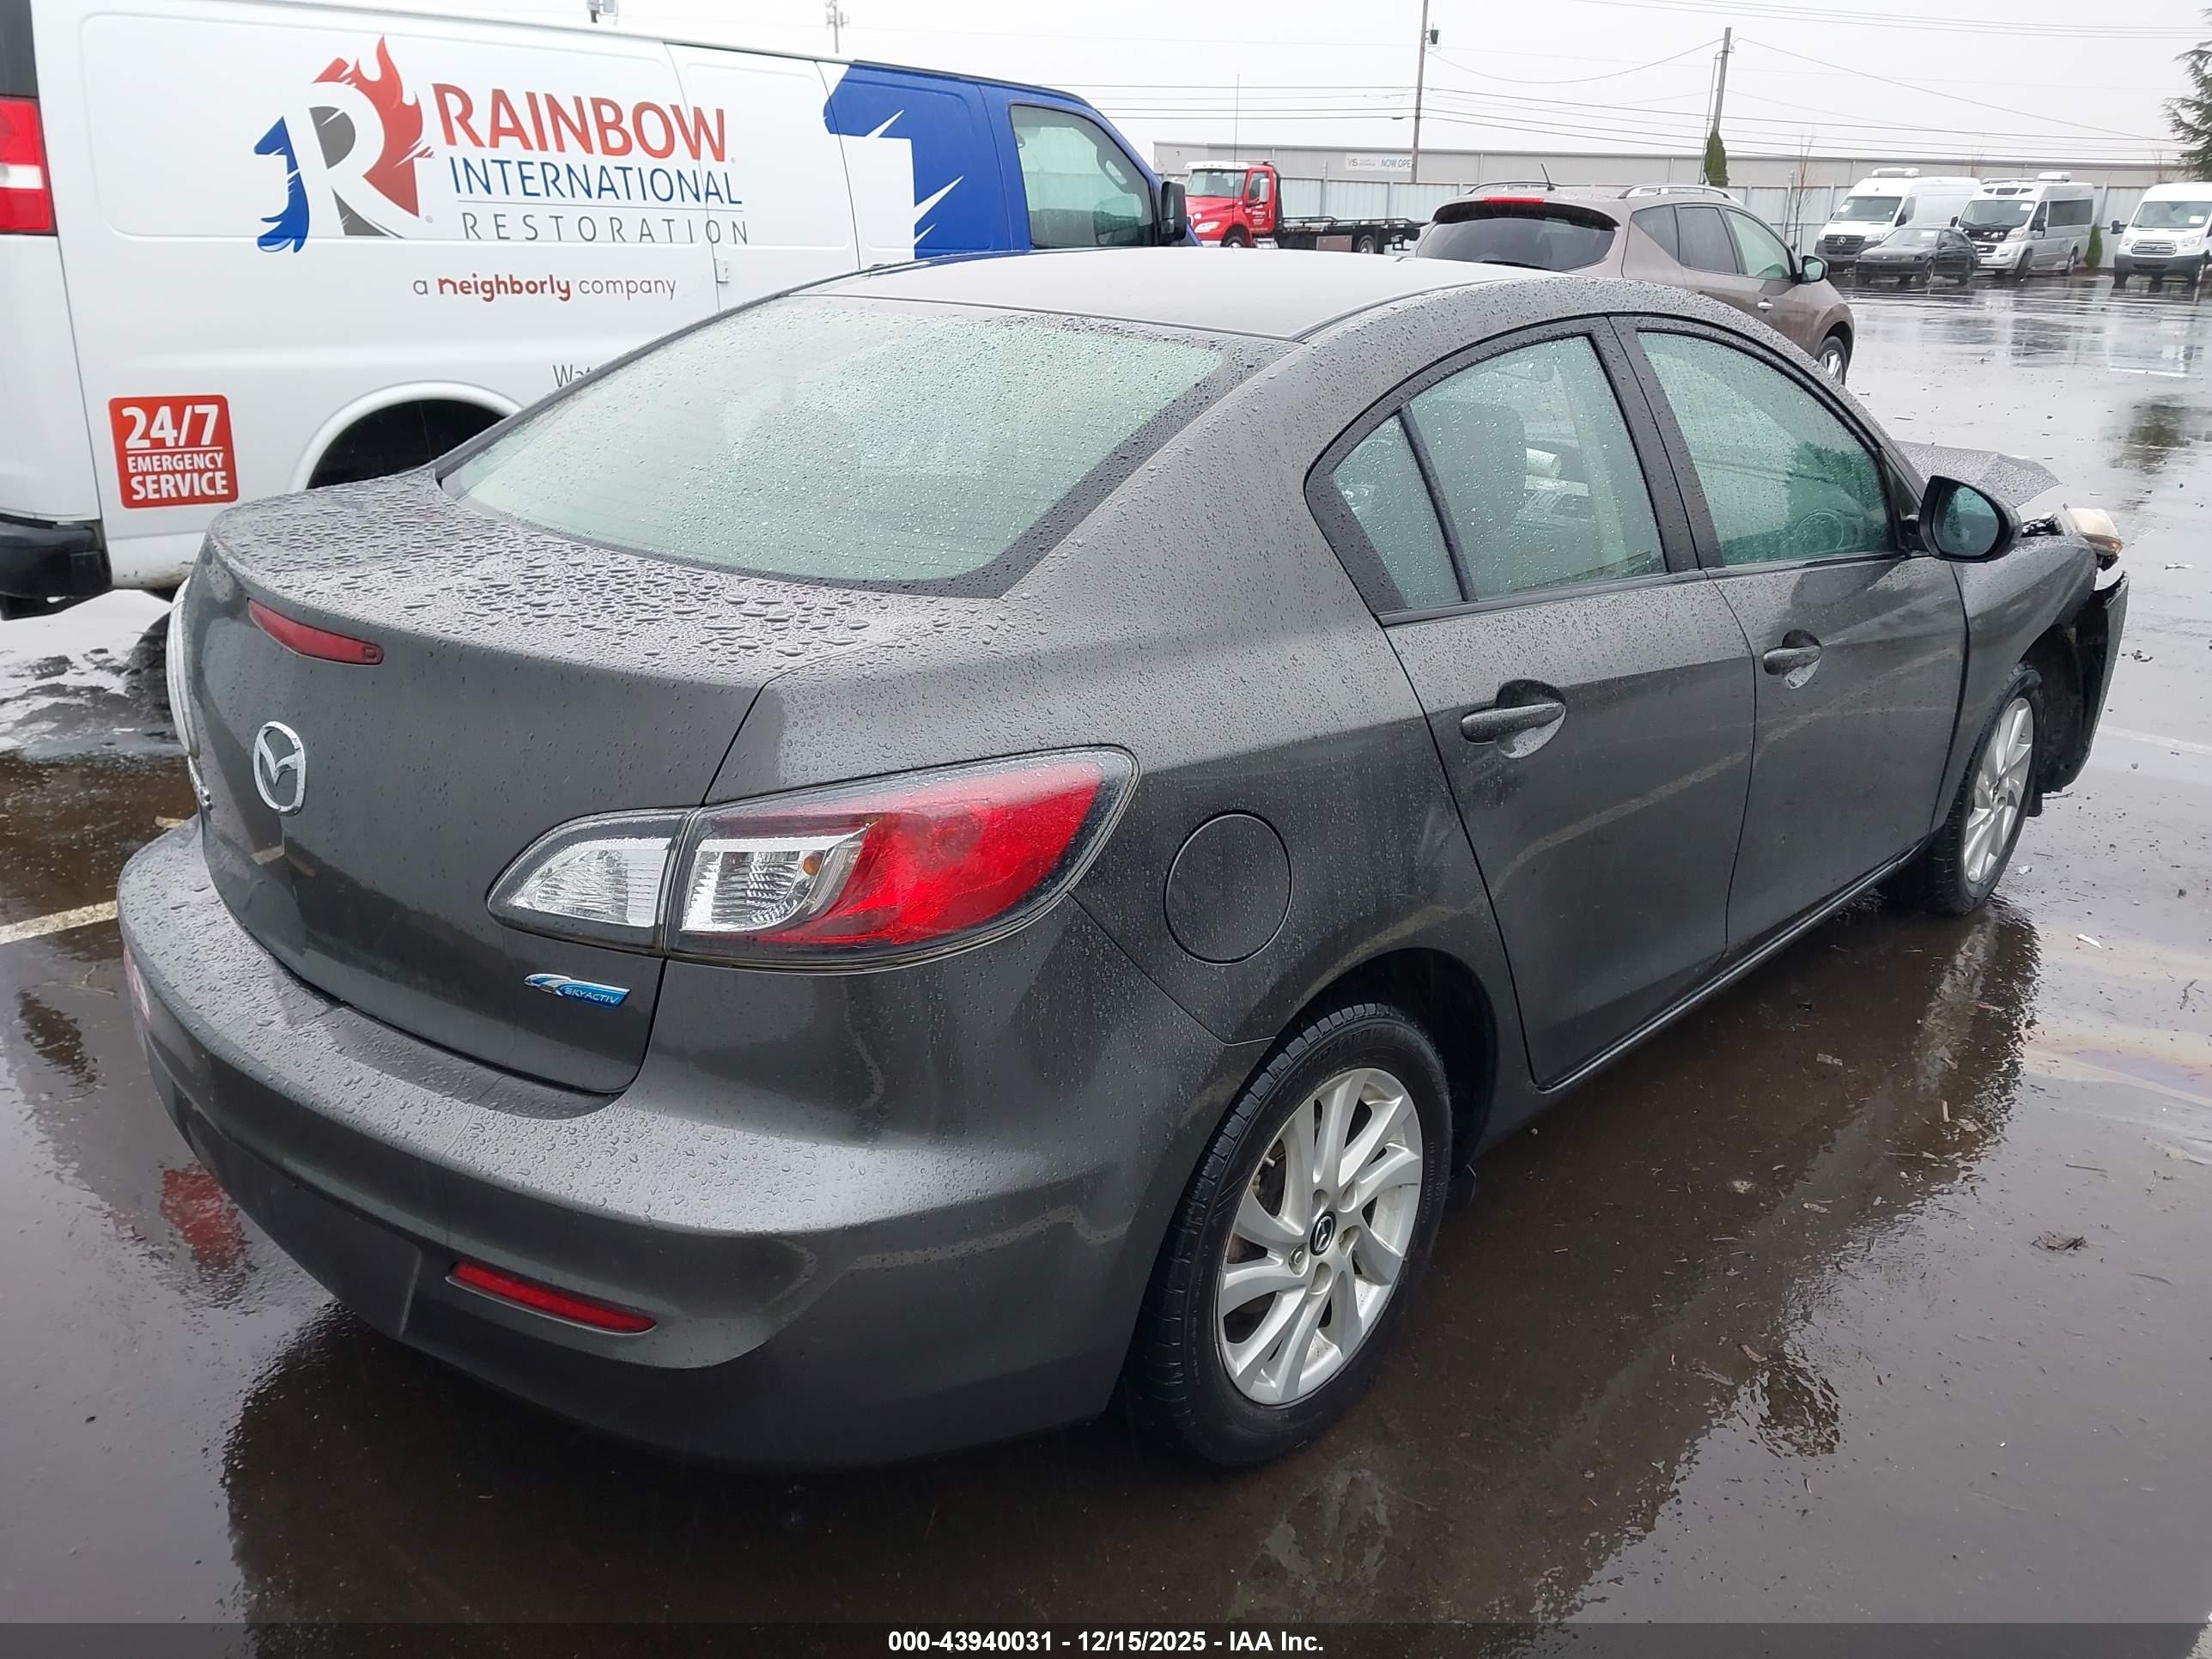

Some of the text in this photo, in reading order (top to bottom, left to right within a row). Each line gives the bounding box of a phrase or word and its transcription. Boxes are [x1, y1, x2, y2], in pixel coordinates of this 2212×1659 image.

[432, 82, 725, 162] RAINBOW
[1397, 158, 1413, 168] OPE
[449, 156, 743, 205] INTERNATIONAL
[462, 212, 748, 245] RESTORATION
[413, 273, 677, 302] a neighborly company
[121, 404, 218, 448] 24/7
[126, 452, 224, 473] EMERGENCY
[130, 471, 229, 501] SERVICE
[564, 988, 618, 1003] SKYACTIV
